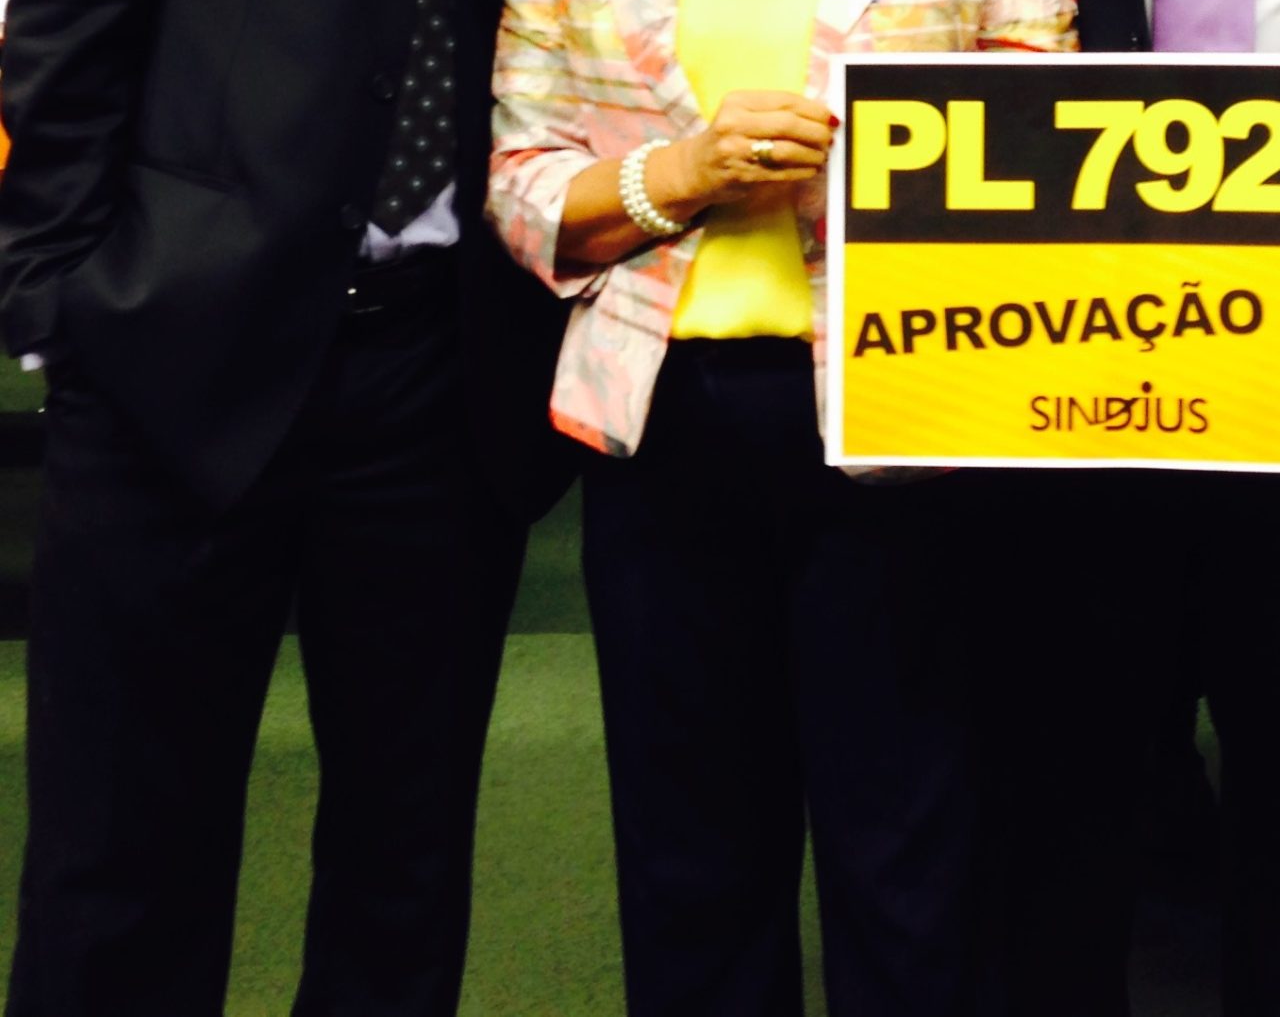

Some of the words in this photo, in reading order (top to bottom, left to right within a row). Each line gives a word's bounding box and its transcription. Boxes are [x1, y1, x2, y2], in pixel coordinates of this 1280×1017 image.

[851, 99, 1036, 211] PL
[852, 281, 1262, 358] APROVAÇÃO
[1029, 381, 1209, 434] SINDJUS
